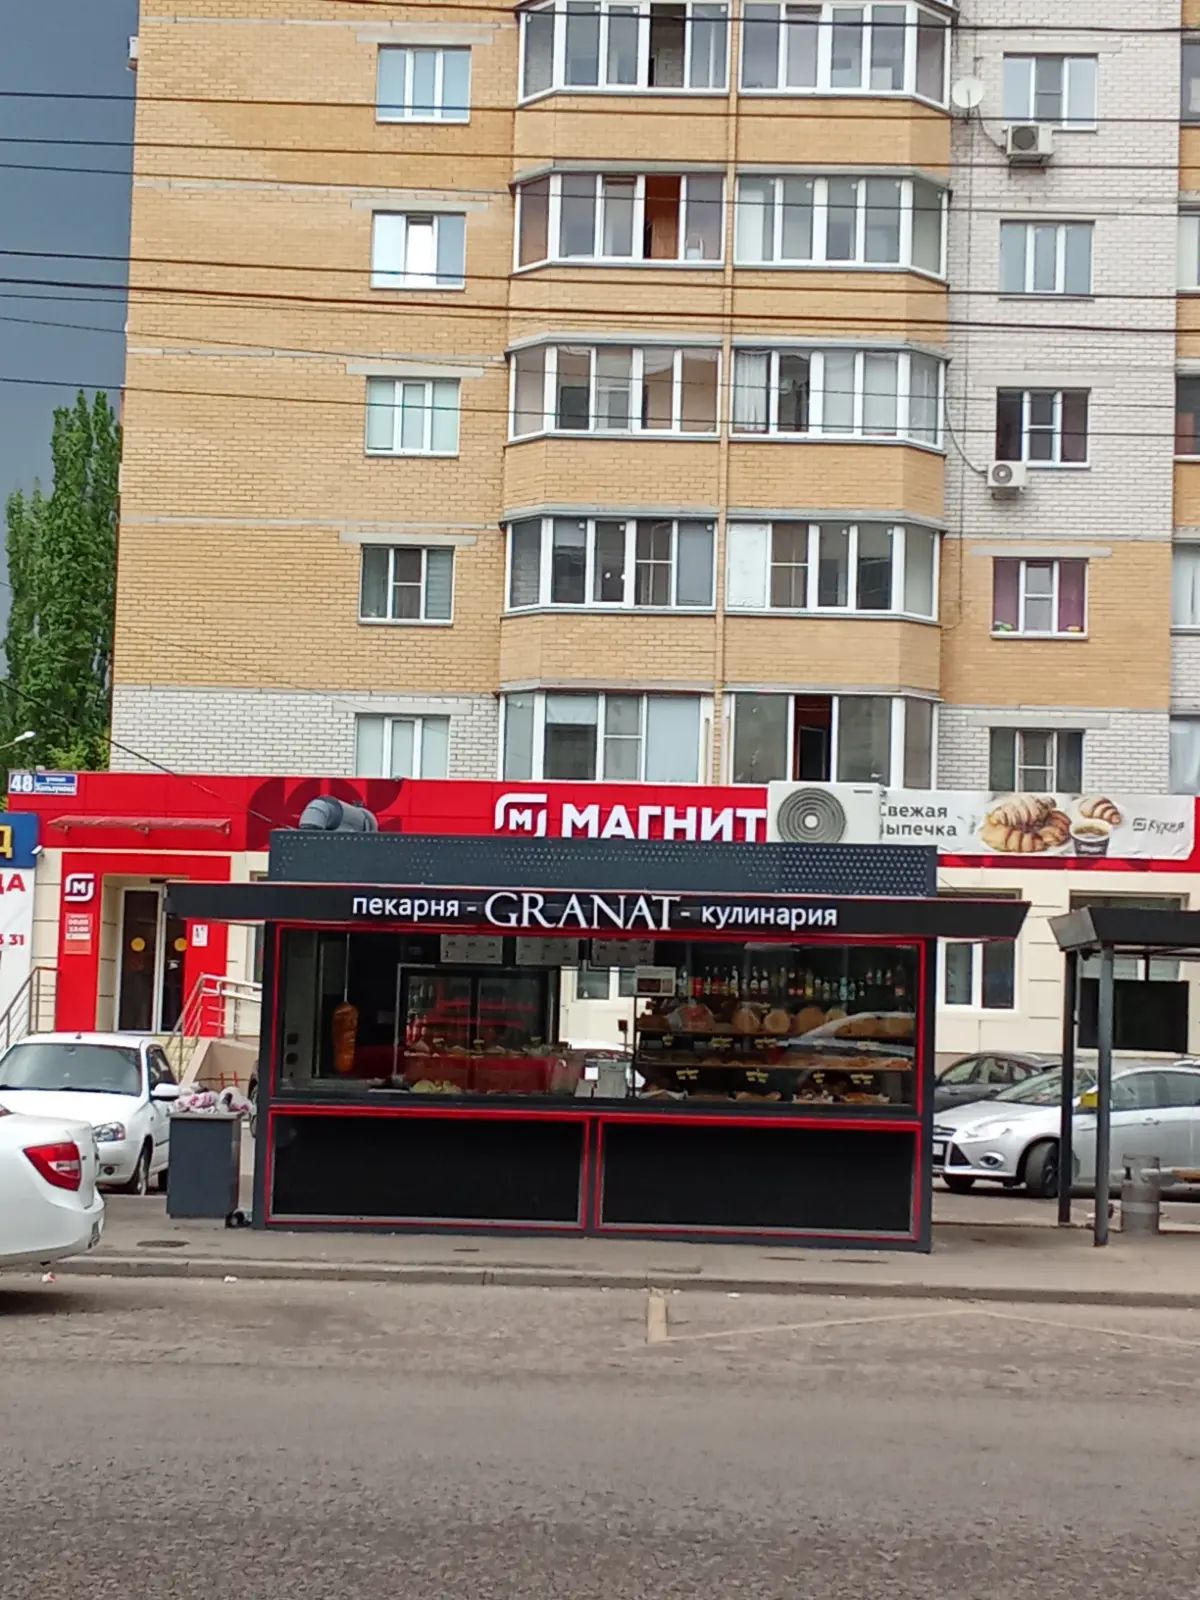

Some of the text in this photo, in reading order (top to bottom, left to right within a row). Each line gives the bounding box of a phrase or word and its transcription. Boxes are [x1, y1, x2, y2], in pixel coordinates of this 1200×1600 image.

[10, 774, 33, 792] 48
[561, 803, 767, 842] МАГНИТ
[352, 897, 459, 921] пекарня
[484, 892, 681, 930] GRANAT
[701, 905, 837, 931] кулинария
[9, 934, 25, 946] 31
